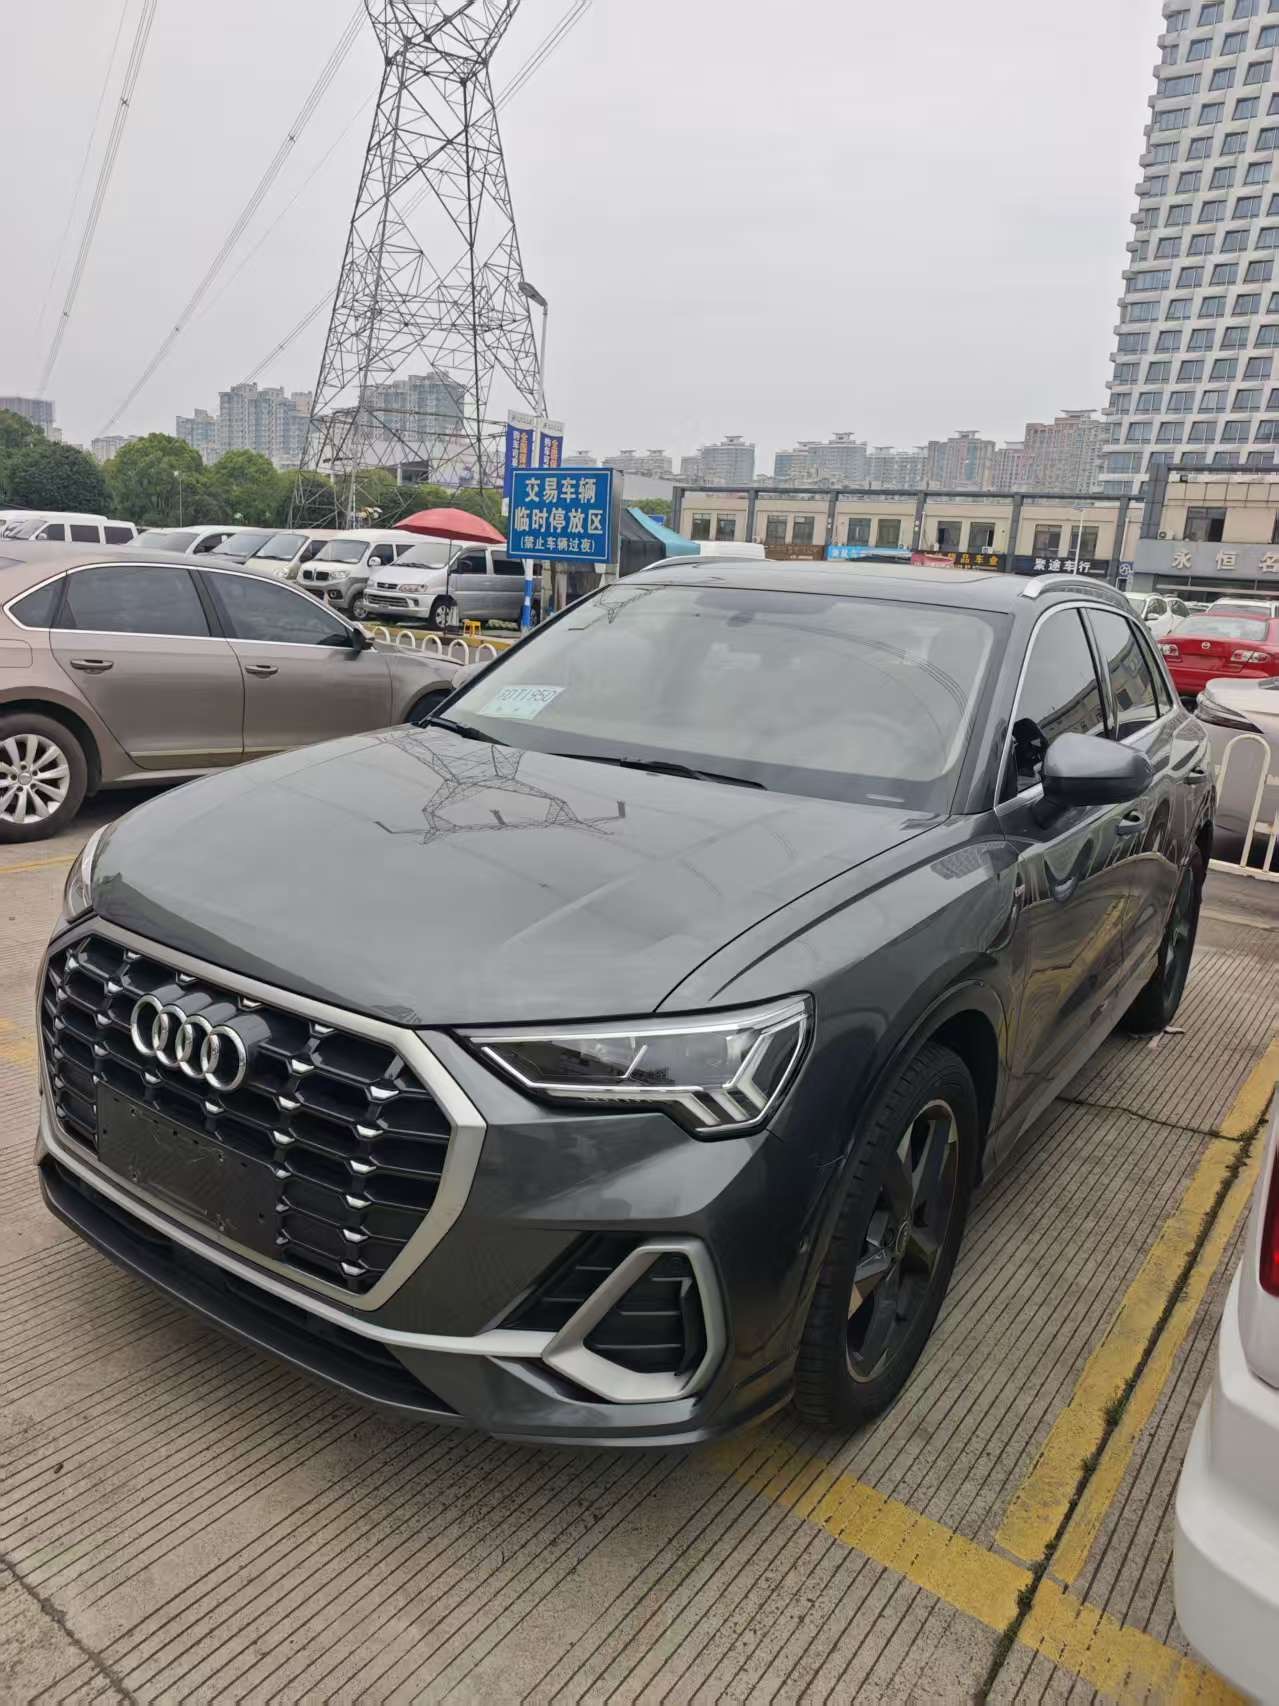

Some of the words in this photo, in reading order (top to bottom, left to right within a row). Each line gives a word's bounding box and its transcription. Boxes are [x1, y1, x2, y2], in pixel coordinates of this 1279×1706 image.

[525, 477, 597, 503] 交易车辆
[514, 507, 603, 534] 临时停放区
